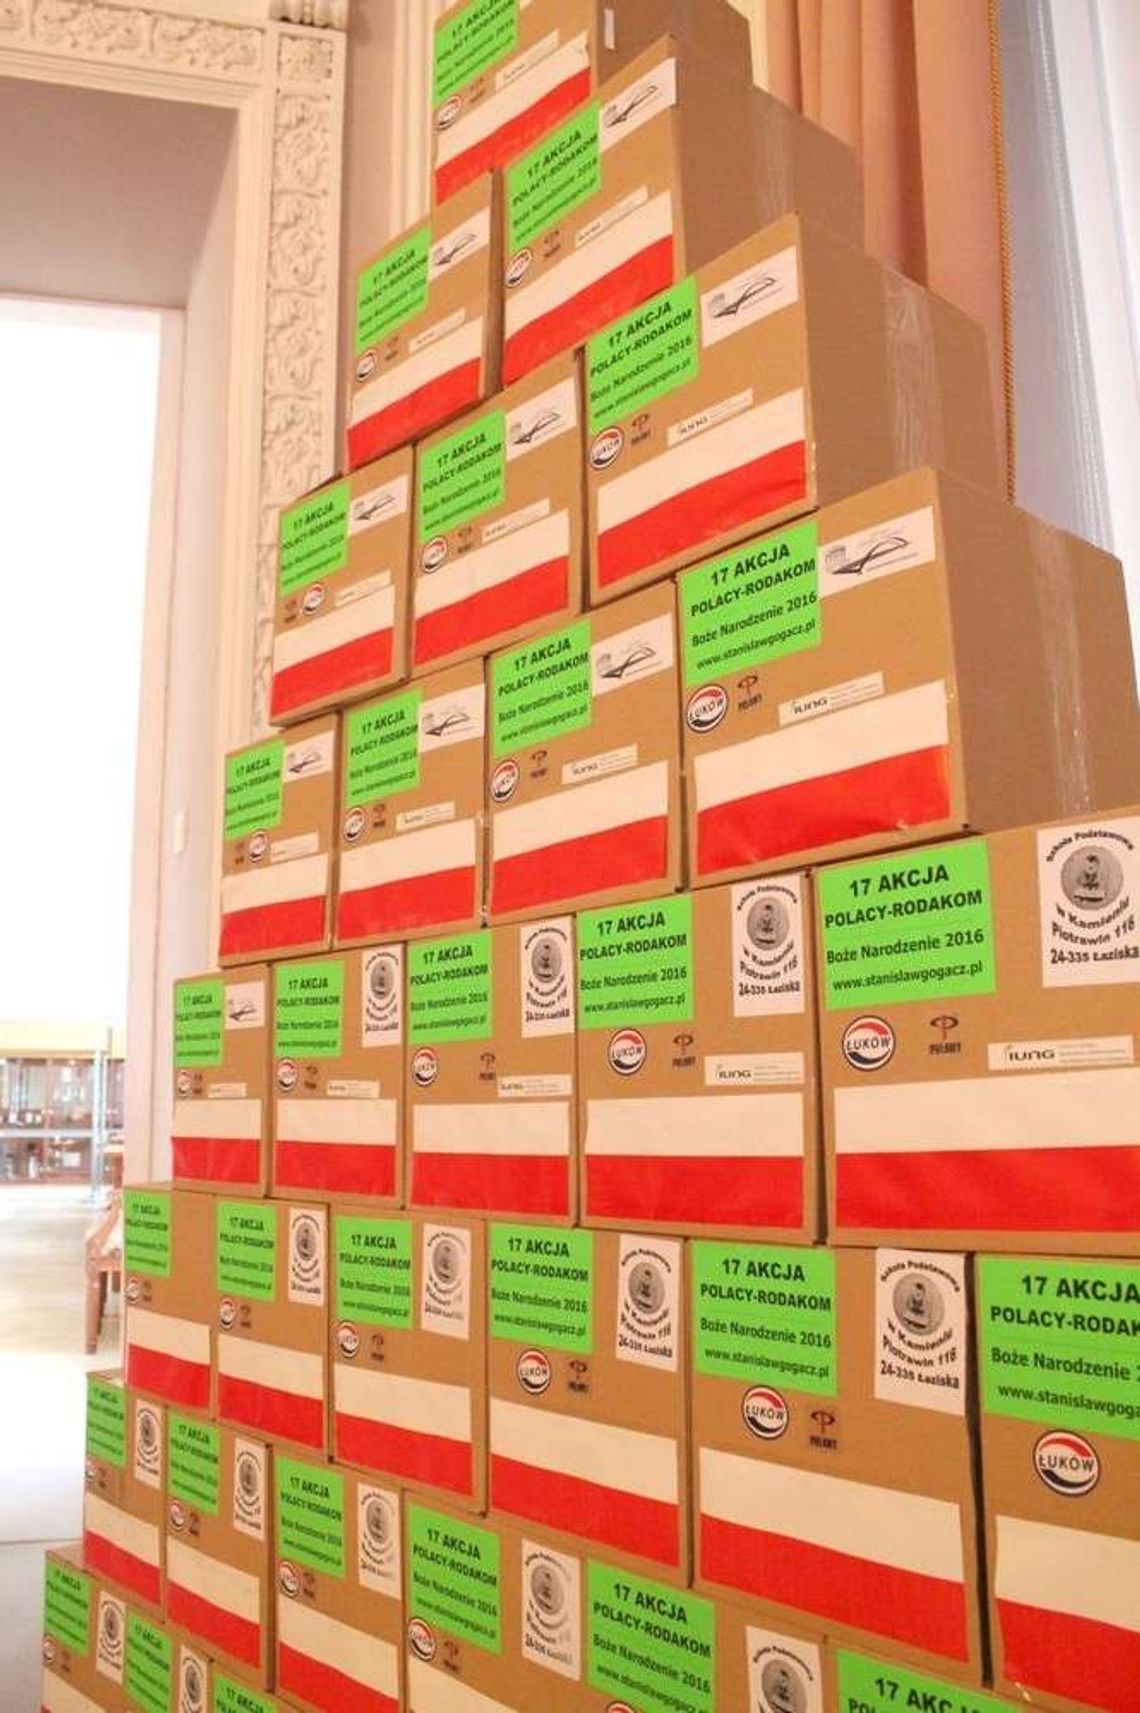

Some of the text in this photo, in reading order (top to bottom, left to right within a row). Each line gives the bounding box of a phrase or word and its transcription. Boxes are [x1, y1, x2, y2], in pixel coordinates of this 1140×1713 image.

[527, 130, 581, 178] 17 AKCJA
[607, 301, 671, 348] 17 AKCJA
[590, 308, 691, 377] POLACY-RODAKOM
[667, 334, 691, 356] 2016
[437, 433, 486, 467] 17 AKCJA
[293, 501, 333, 531] 17 AKCJA
[711, 543, 790, 586] 17 AKCJA
[691, 558, 815, 617] POLACY-RODAKOM
[692, 591, 817, 647] Boże Narodzenie 2016
[514, 638, 570, 671] 17 AKCJA
[697, 618, 816, 669] www.stanislawgogacz.pl
[499, 651, 588, 696] POLACY-RODAKOM
[362, 710, 404, 735] 17 AKCJA
[849, 864, 949, 897] 17 AKCJA
[597, 911, 665, 936] 17 AKCJA
[825, 889, 982, 928] POLACY-RODAKOM
[580, 934, 686, 960] POLACY-RODAKOM
[827, 928, 984, 964] Boże Narodzenie 2016
[1052, 921, 1110, 946] Piotrawin
[423, 944, 472, 965] 17 AKCJA
[288, 977, 328, 990] 17 AKCJA
[410, 963, 488, 986] POLACY-RODAKOM
[604, 970, 657, 987] Narodzenie
[661, 966, 686, 980] 2016
[833, 960, 982, 990] www.stanislawgogacz.pl
[351, 1233, 396, 1250] 17 AKCJA
[508, 1237, 569, 1257] 17 AKCJA
[492, 1260, 588, 1282] POLACY-RODAKOM
[722, 1257, 805, 1282] 17 AKCJA
[701, 1284, 832, 1312] POLACY-RODAKOM
[1021, 1274, 1140, 1304] 17 AKCJA
[564, 1298, 587, 1313] 2016
[702, 1318, 832, 1349] Boże Narodzenie 2016
[706, 1349, 829, 1379] www.stanislawgogacz.pl
[993, 1348, 1129, 1382] Boże Narodzenie
[427, 1527, 480, 1560] 17 AKCJA
[413, 1544, 497, 1588] POLACY-RODAKOM
[614, 1582, 688, 1624] 17 AKCJA
[595, 1602, 711, 1660] POLACY-RODAKOM
[681, 1671, 710, 1695] 2016
[875, 1677, 899, 1700] 17
